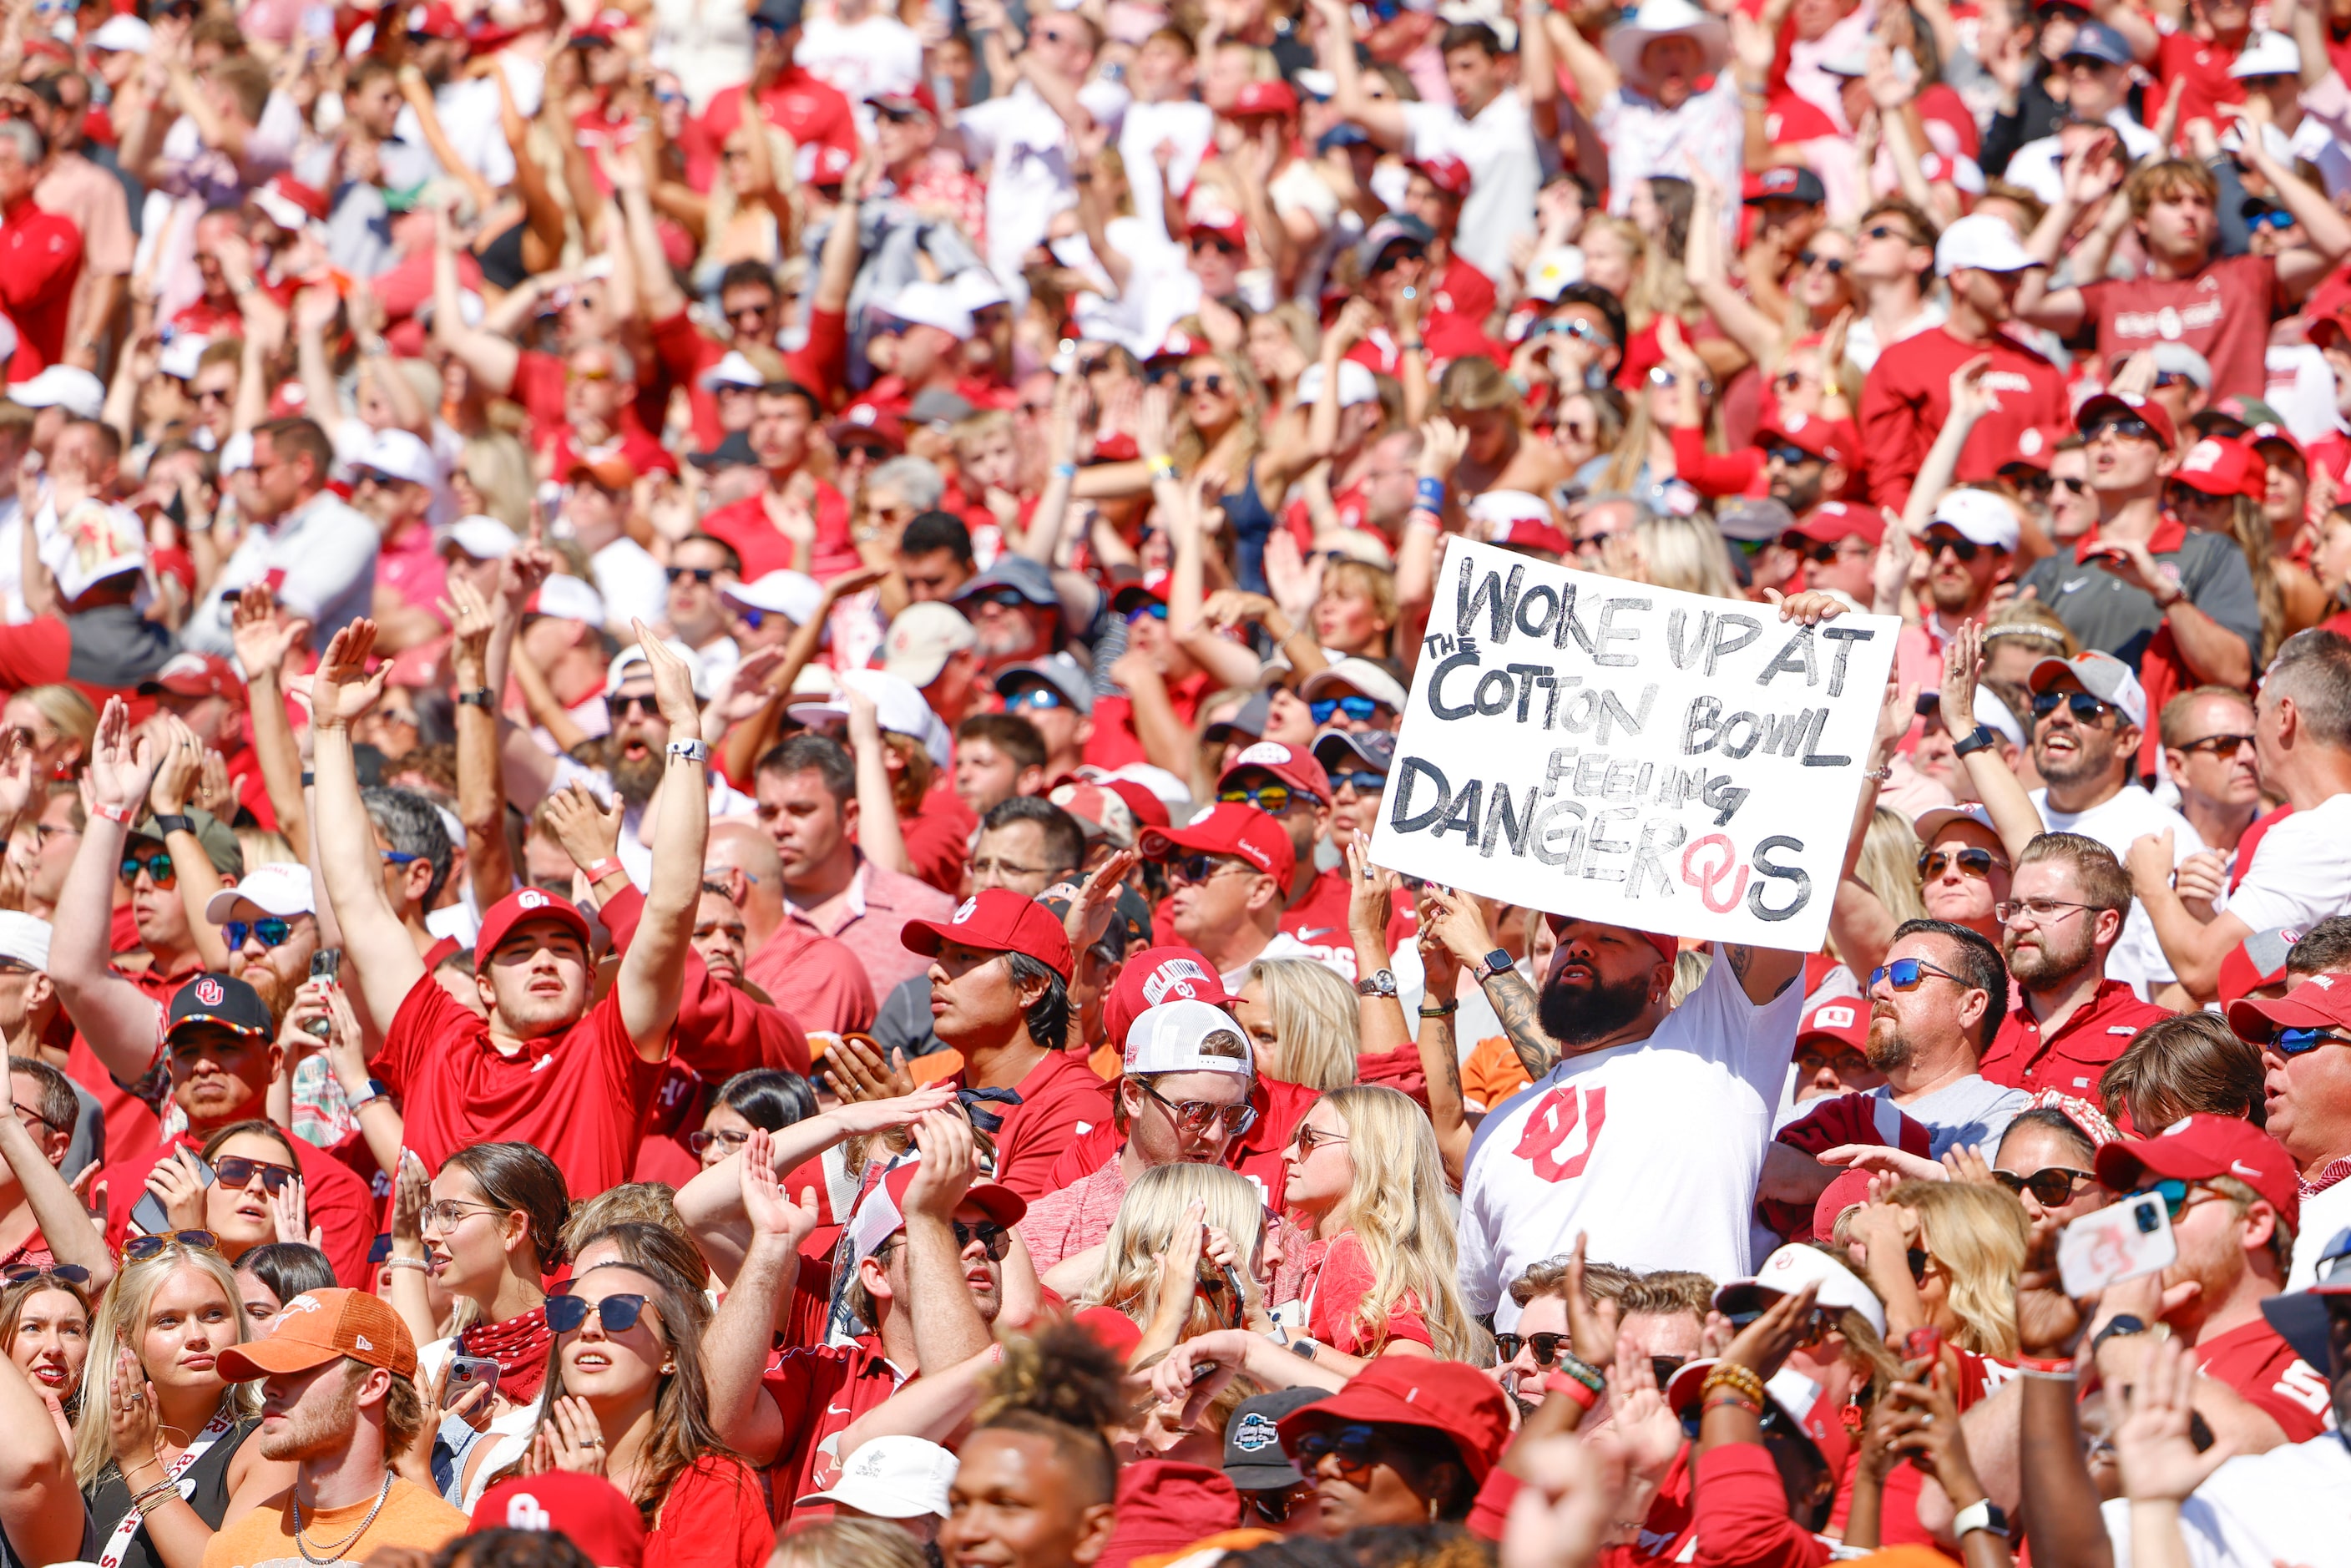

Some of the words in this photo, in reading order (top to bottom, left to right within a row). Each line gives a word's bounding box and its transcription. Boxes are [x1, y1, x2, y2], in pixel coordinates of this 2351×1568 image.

[1423, 633, 1481, 659] THE
[1457, 556, 1652, 667] WOKE
[1667, 608, 1763, 677] UP
[1756, 623, 1875, 698] AT
[1428, 652, 1659, 746] COTTON
[1679, 695, 1851, 766] BOWL
[1543, 747, 1750, 827] FEELING
[195, 978, 224, 1006] OU
[1174, 980, 1197, 999] OU
[1510, 1083, 1607, 1184] OU
